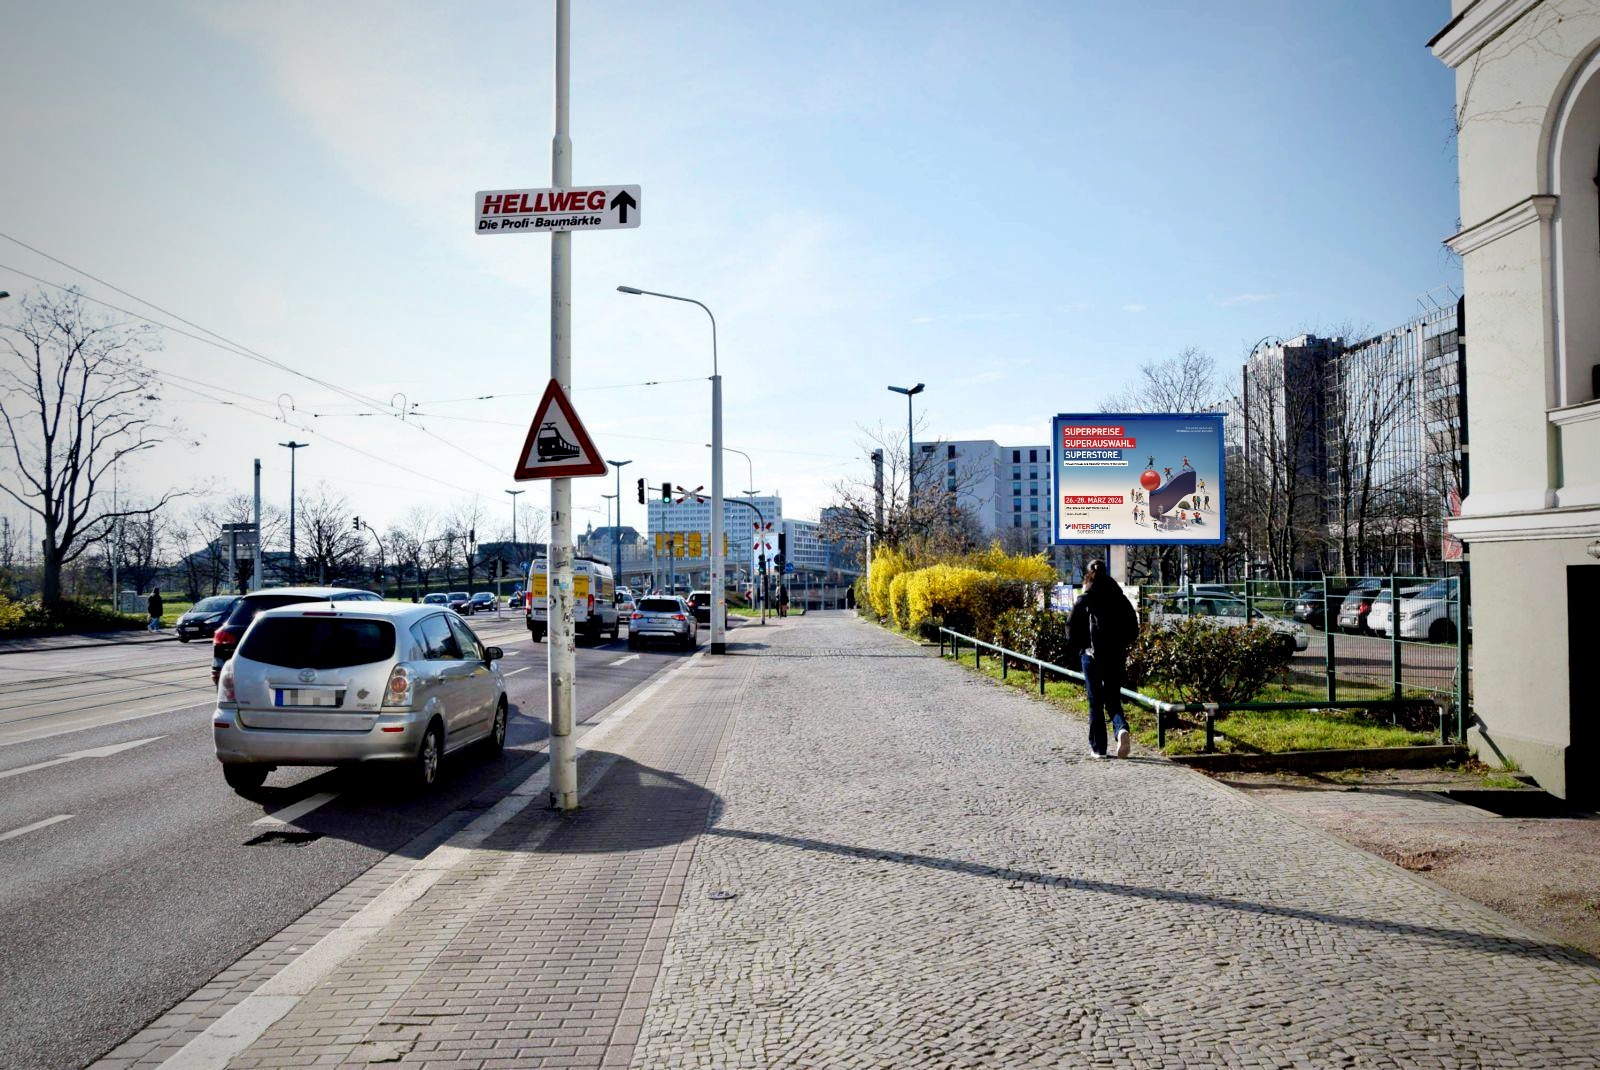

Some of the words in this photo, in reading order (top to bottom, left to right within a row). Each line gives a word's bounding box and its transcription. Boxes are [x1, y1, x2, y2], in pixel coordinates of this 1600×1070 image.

[482, 190, 606, 215] HELLWEG
[478, 219, 498, 230] Die
[501, 215, 602, 229] Profi-Baumärkte
[1064, 427, 1123, 436] SUPERPREISE.
[1065, 439, 1134, 448] SUPERAUSWAHL.
[1065, 450, 1121, 459] SUPERSTORE.
[1087, 495, 1107, 504] MÄRZ
